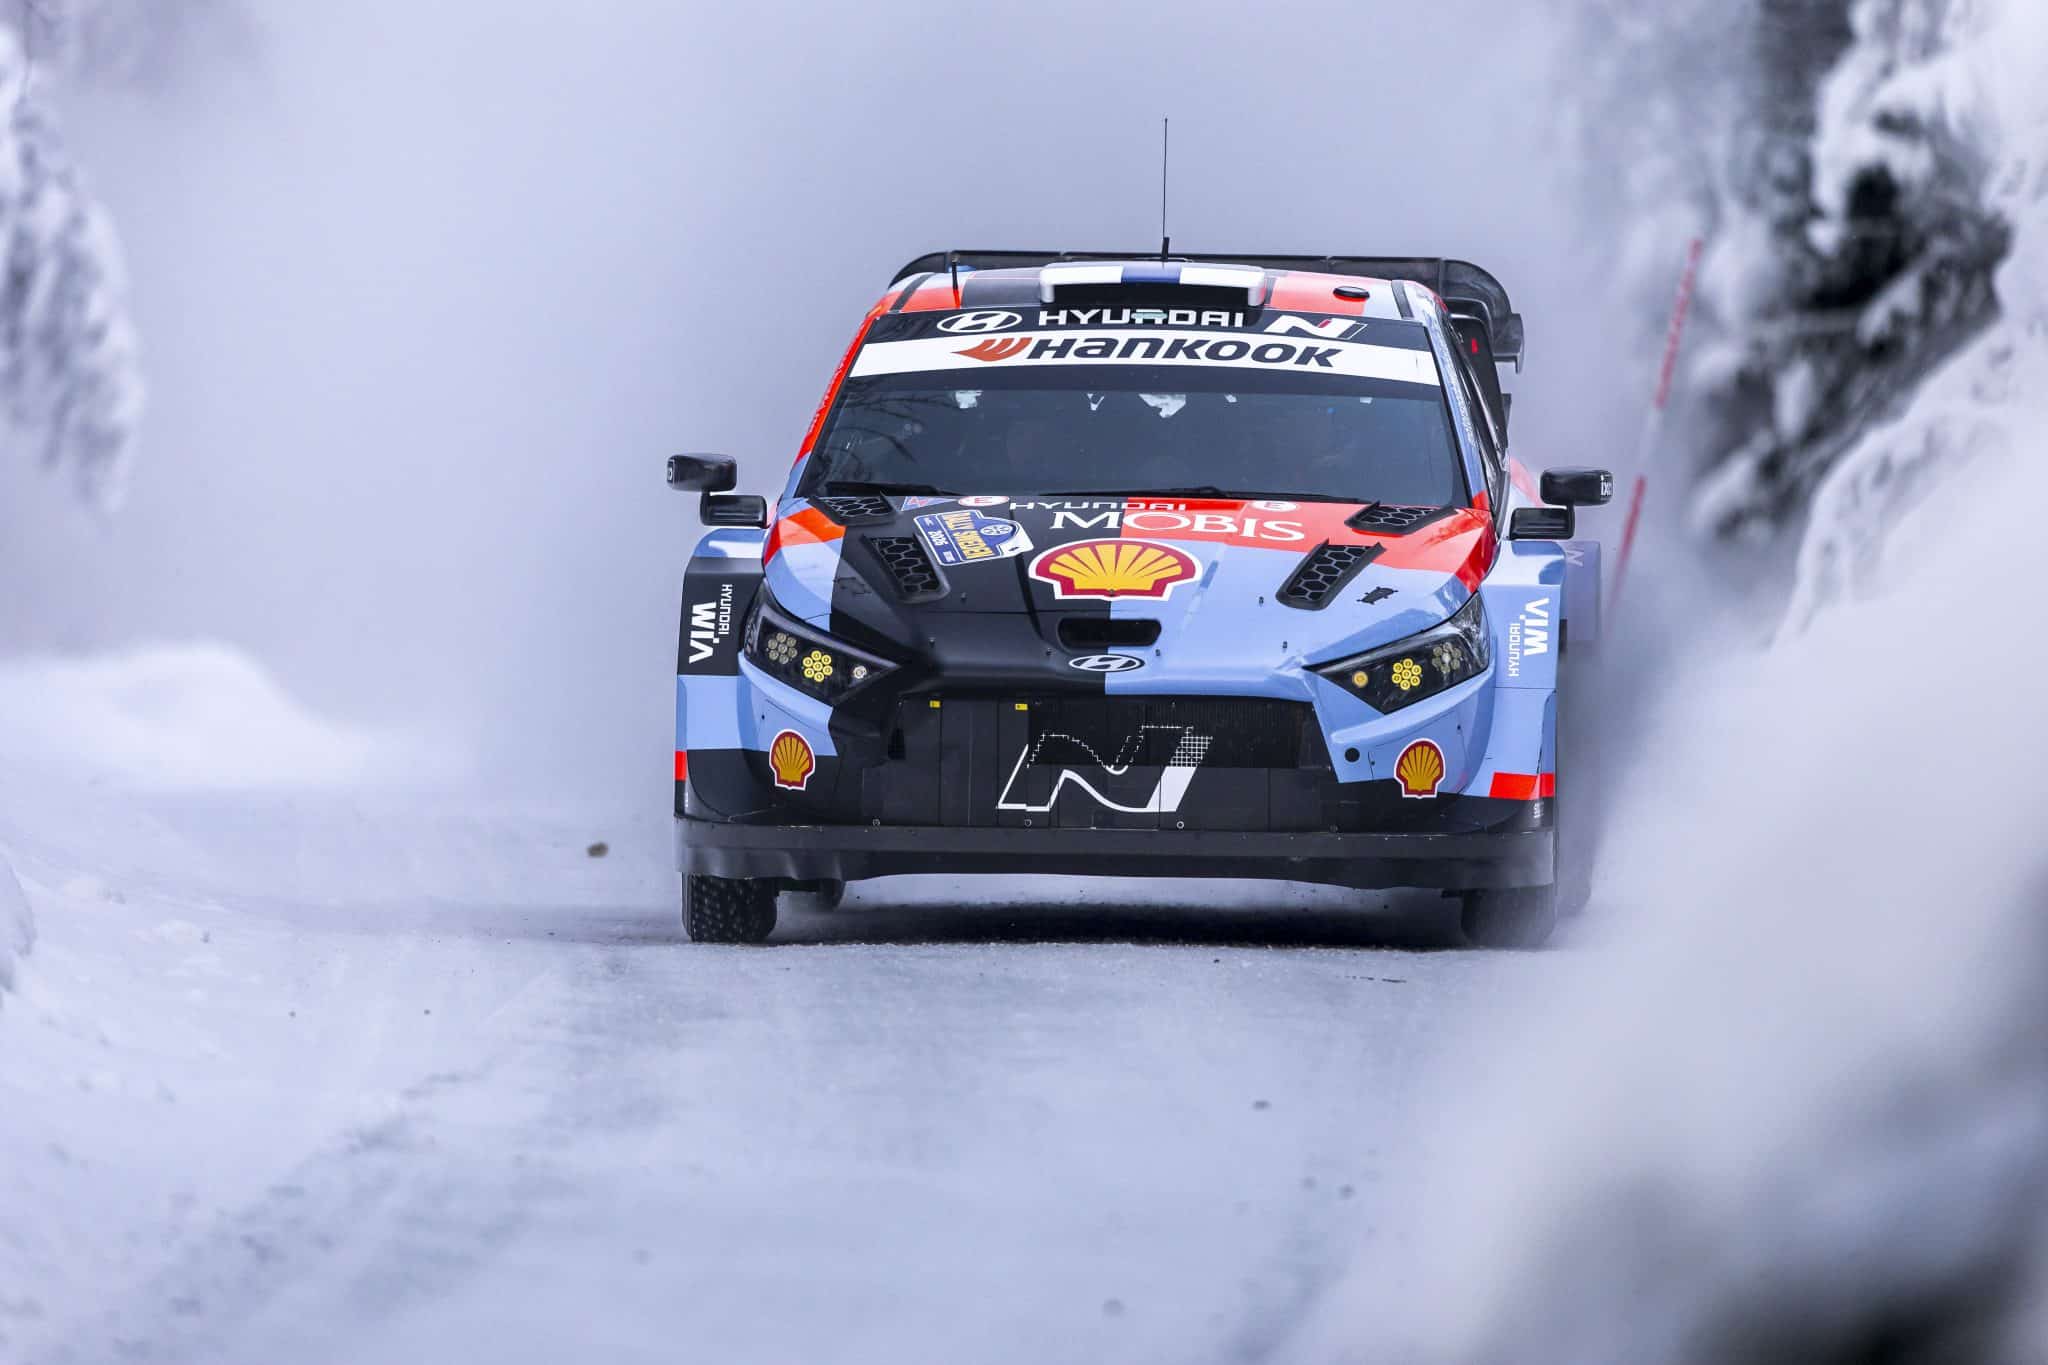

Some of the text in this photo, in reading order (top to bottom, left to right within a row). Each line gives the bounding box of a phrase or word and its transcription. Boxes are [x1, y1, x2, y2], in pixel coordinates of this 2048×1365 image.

[1038, 308, 1244, 328] HYUNDAI
[1009, 501, 1187, 511] HYUNDAI
[1050, 511, 1305, 541] MOBIS
[953, 530, 995, 559] SWEDEN
[719, 584, 733, 635] HYUNDAI
[1508, 623, 1520, 677] HYUNDAI
